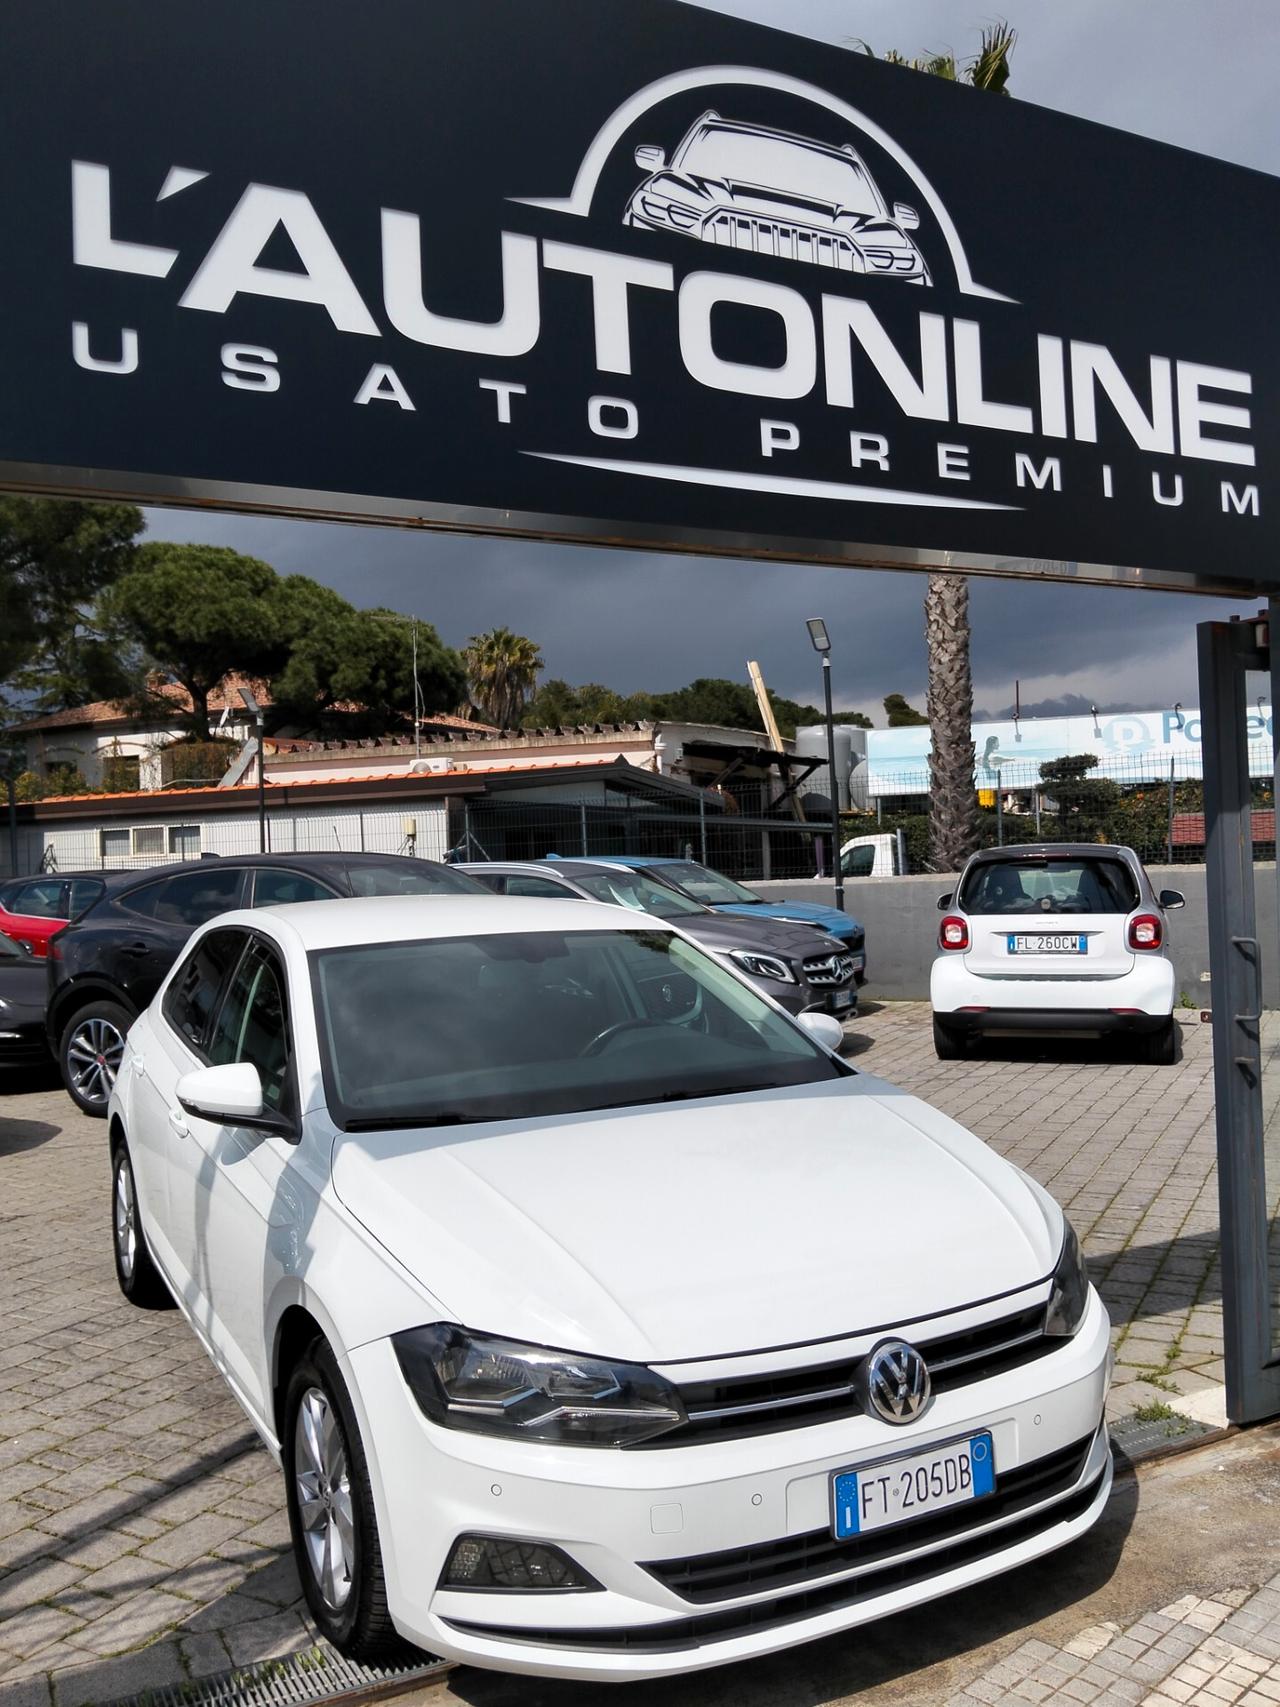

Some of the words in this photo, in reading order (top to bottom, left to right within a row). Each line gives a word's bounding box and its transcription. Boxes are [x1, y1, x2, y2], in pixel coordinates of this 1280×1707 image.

[71, 160, 1256, 466] L'AUTONLINE
[71, 320, 639, 440] USATO
[760, 418, 1260, 516] PREMIUM
